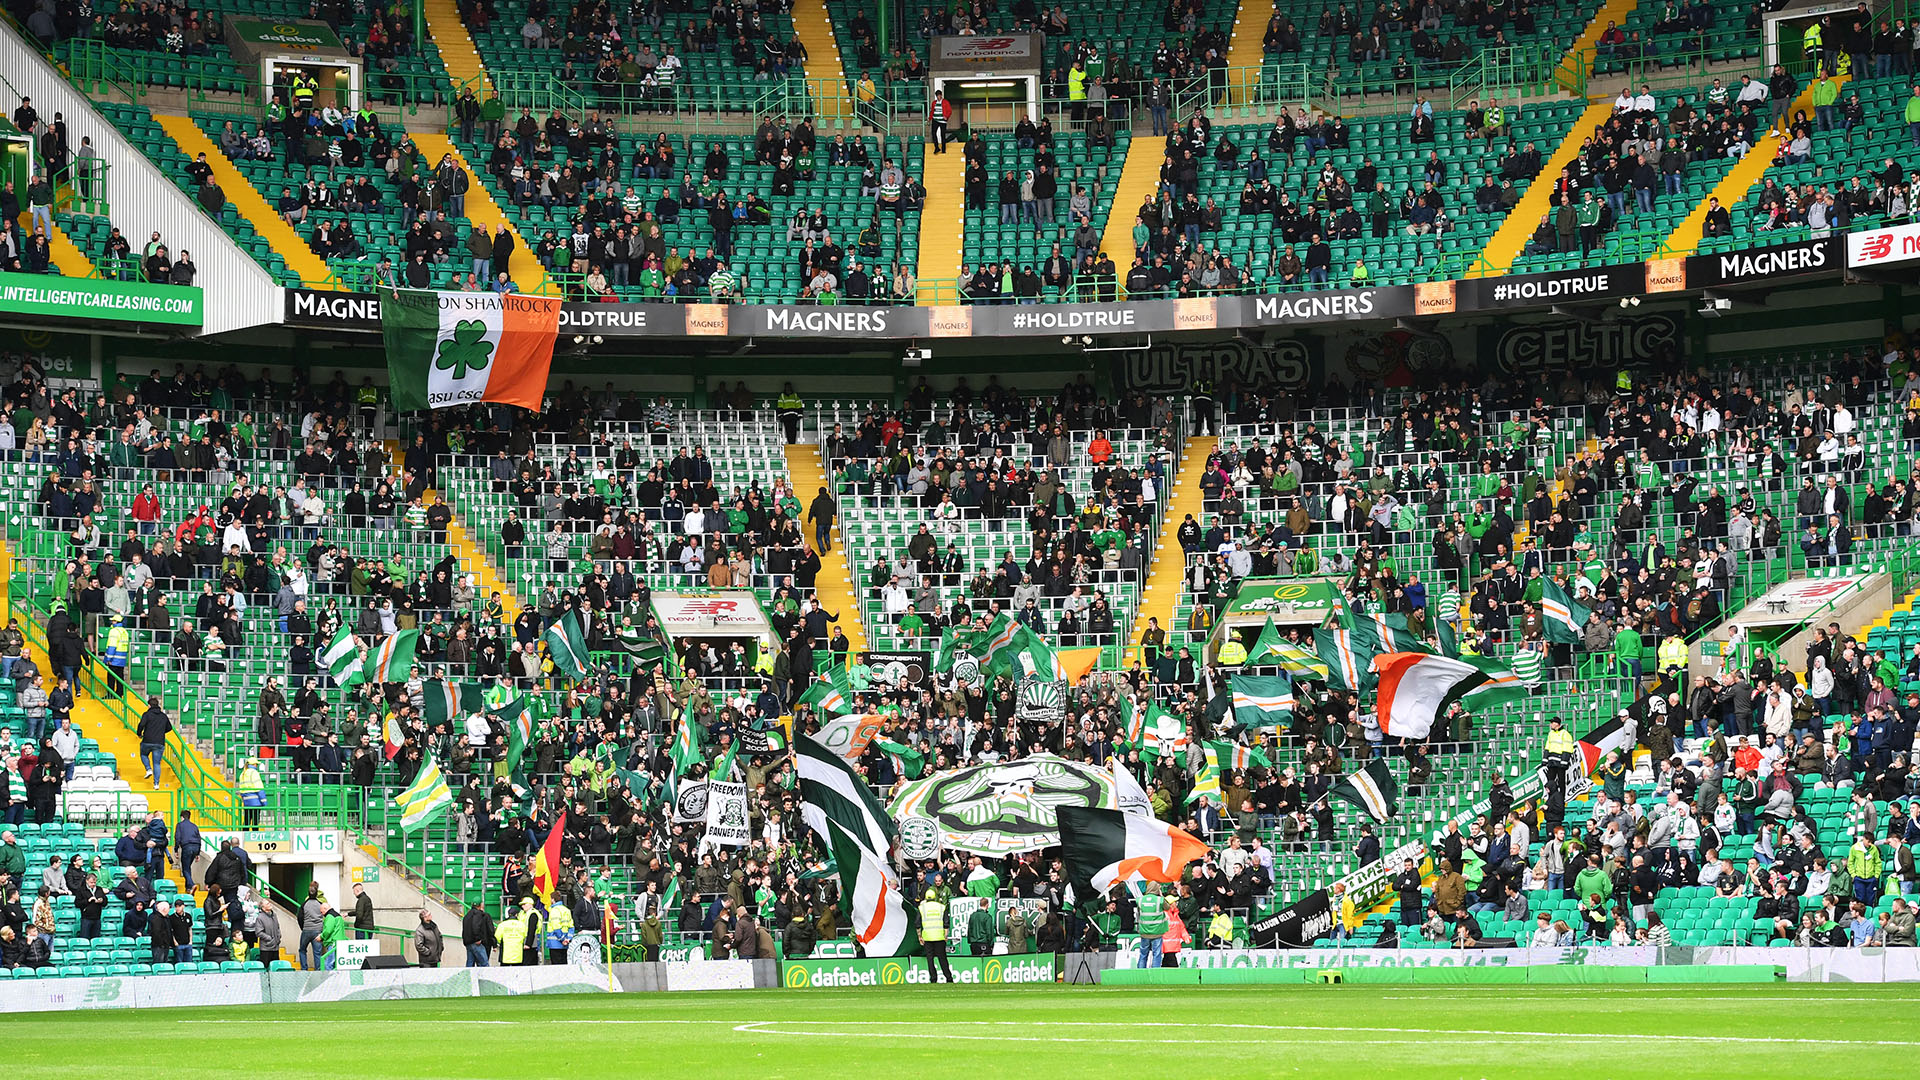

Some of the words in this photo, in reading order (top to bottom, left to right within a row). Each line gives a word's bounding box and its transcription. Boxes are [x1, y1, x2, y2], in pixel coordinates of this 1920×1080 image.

[259, 34, 323, 43] dafabet
[1720, 243, 1826, 279] MAGNERS
[1494, 275, 1609, 301] #HOLDTRUE
[1649, 275, 1683, 286] MAGNERS
[294, 293, 382, 320] MAGNE
[465, 297, 552, 312] SHAMROCK
[1256, 292, 1373, 319] MAGNERS
[1419, 297, 1453, 308] MAGNERS
[691, 319, 725, 329] MAGNERS
[767, 309, 886, 332] MAGNERS
[1013, 310, 1135, 328] #HOLDTRUE
[1178, 313, 1214, 322] MAGNERS
[933, 322, 969, 331] MAGNERS
[1503, 322, 1673, 367] CELTIC
[1130, 341, 1304, 389] ULTRAS
[709, 782, 744, 796] FREEDOM
[1472, 798, 1493, 815] CELT
[709, 826, 735, 839] BANNED
[257, 842, 277, 851] 109
[296, 834, 309, 851] N
[318, 834, 335, 851] 15
[1327, 861, 1384, 898] UTRAS
[348, 944, 369, 953] Exit
[338, 957, 363, 966] Gate
[811, 967, 877, 986] dafabet
[1003, 959, 1053, 983] dafabet
